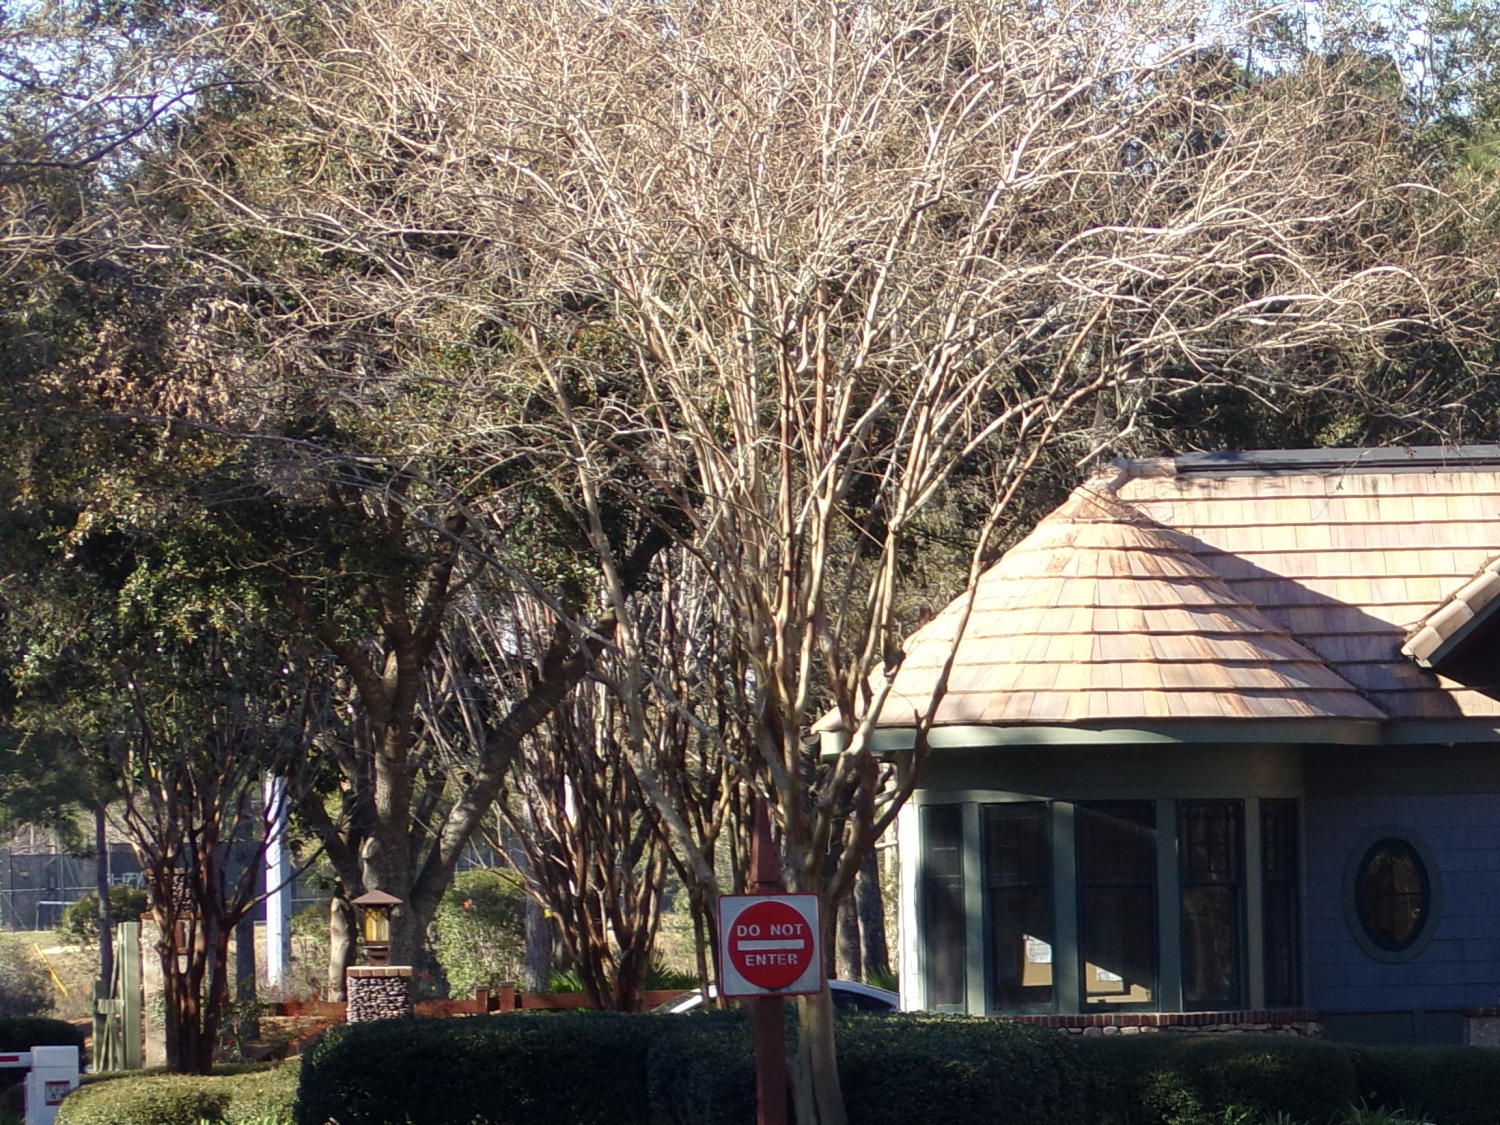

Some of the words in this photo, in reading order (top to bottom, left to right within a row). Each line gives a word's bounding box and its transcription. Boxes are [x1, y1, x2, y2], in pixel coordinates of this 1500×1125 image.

[737, 925, 760, 937] DO
[770, 923, 803, 936] NOT
[745, 953, 798, 966] ENTER
